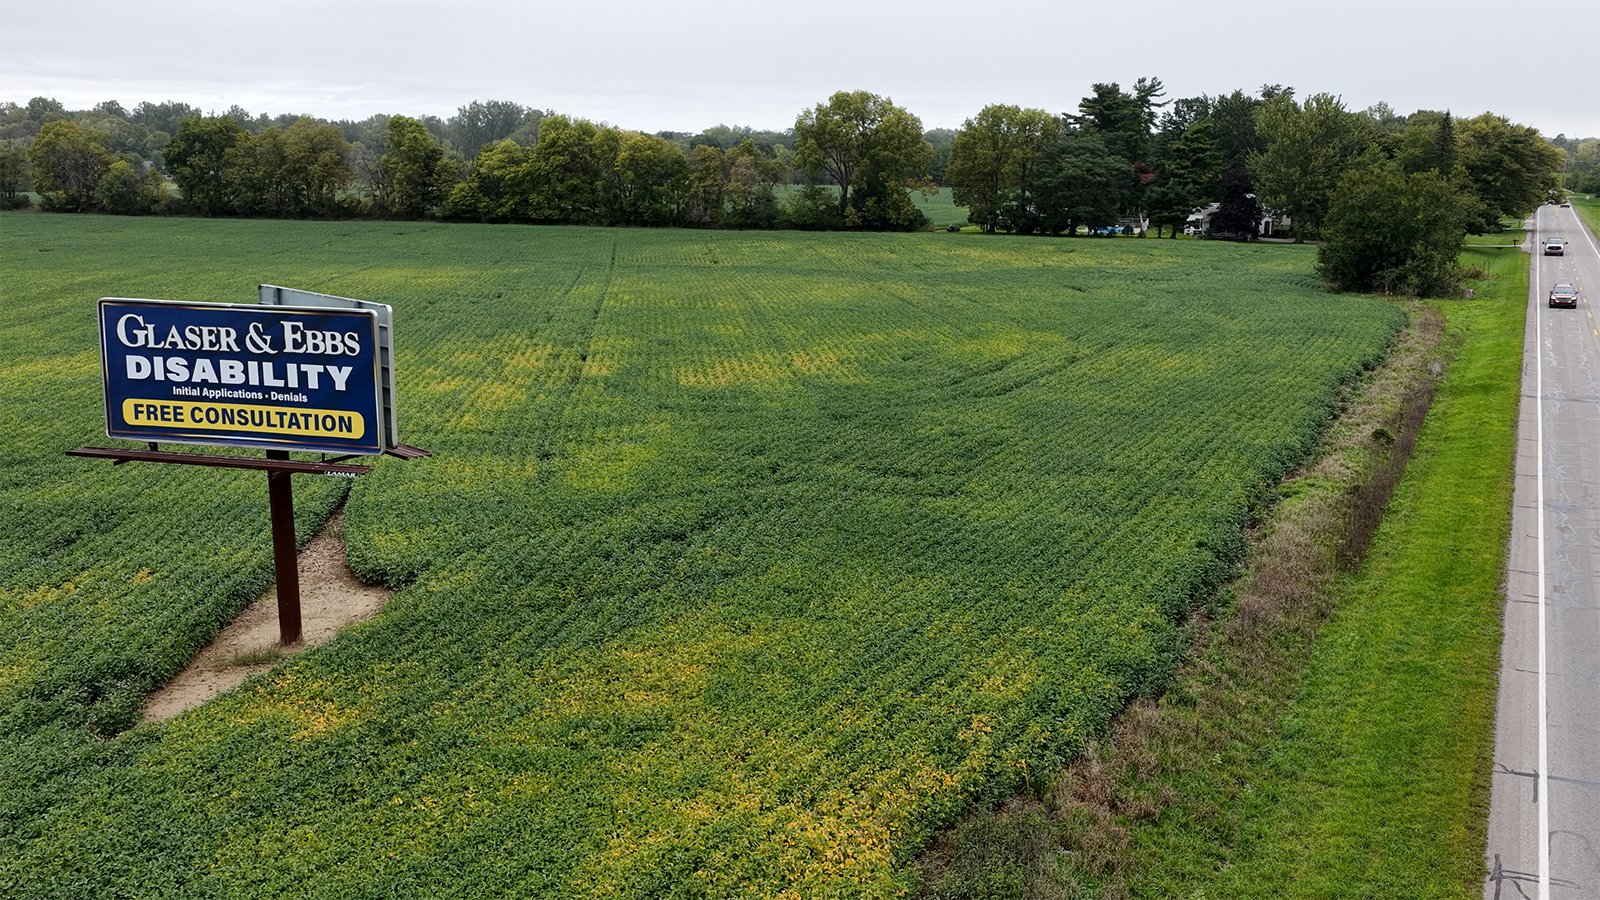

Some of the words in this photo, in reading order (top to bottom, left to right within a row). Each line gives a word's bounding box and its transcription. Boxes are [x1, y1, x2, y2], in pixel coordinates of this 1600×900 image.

[116, 313, 240, 352] GLASER
[245, 322, 278, 355] &
[280, 320, 360, 356] EBBS
[126, 355, 353, 391] DISABILITY
[173, 386, 200, 396] Initial
[202, 387, 263, 400] Applications
[271, 391, 308, 402] Denials
[133, 403, 185, 422] FREE
[190, 406, 353, 433] CONSULTATION
